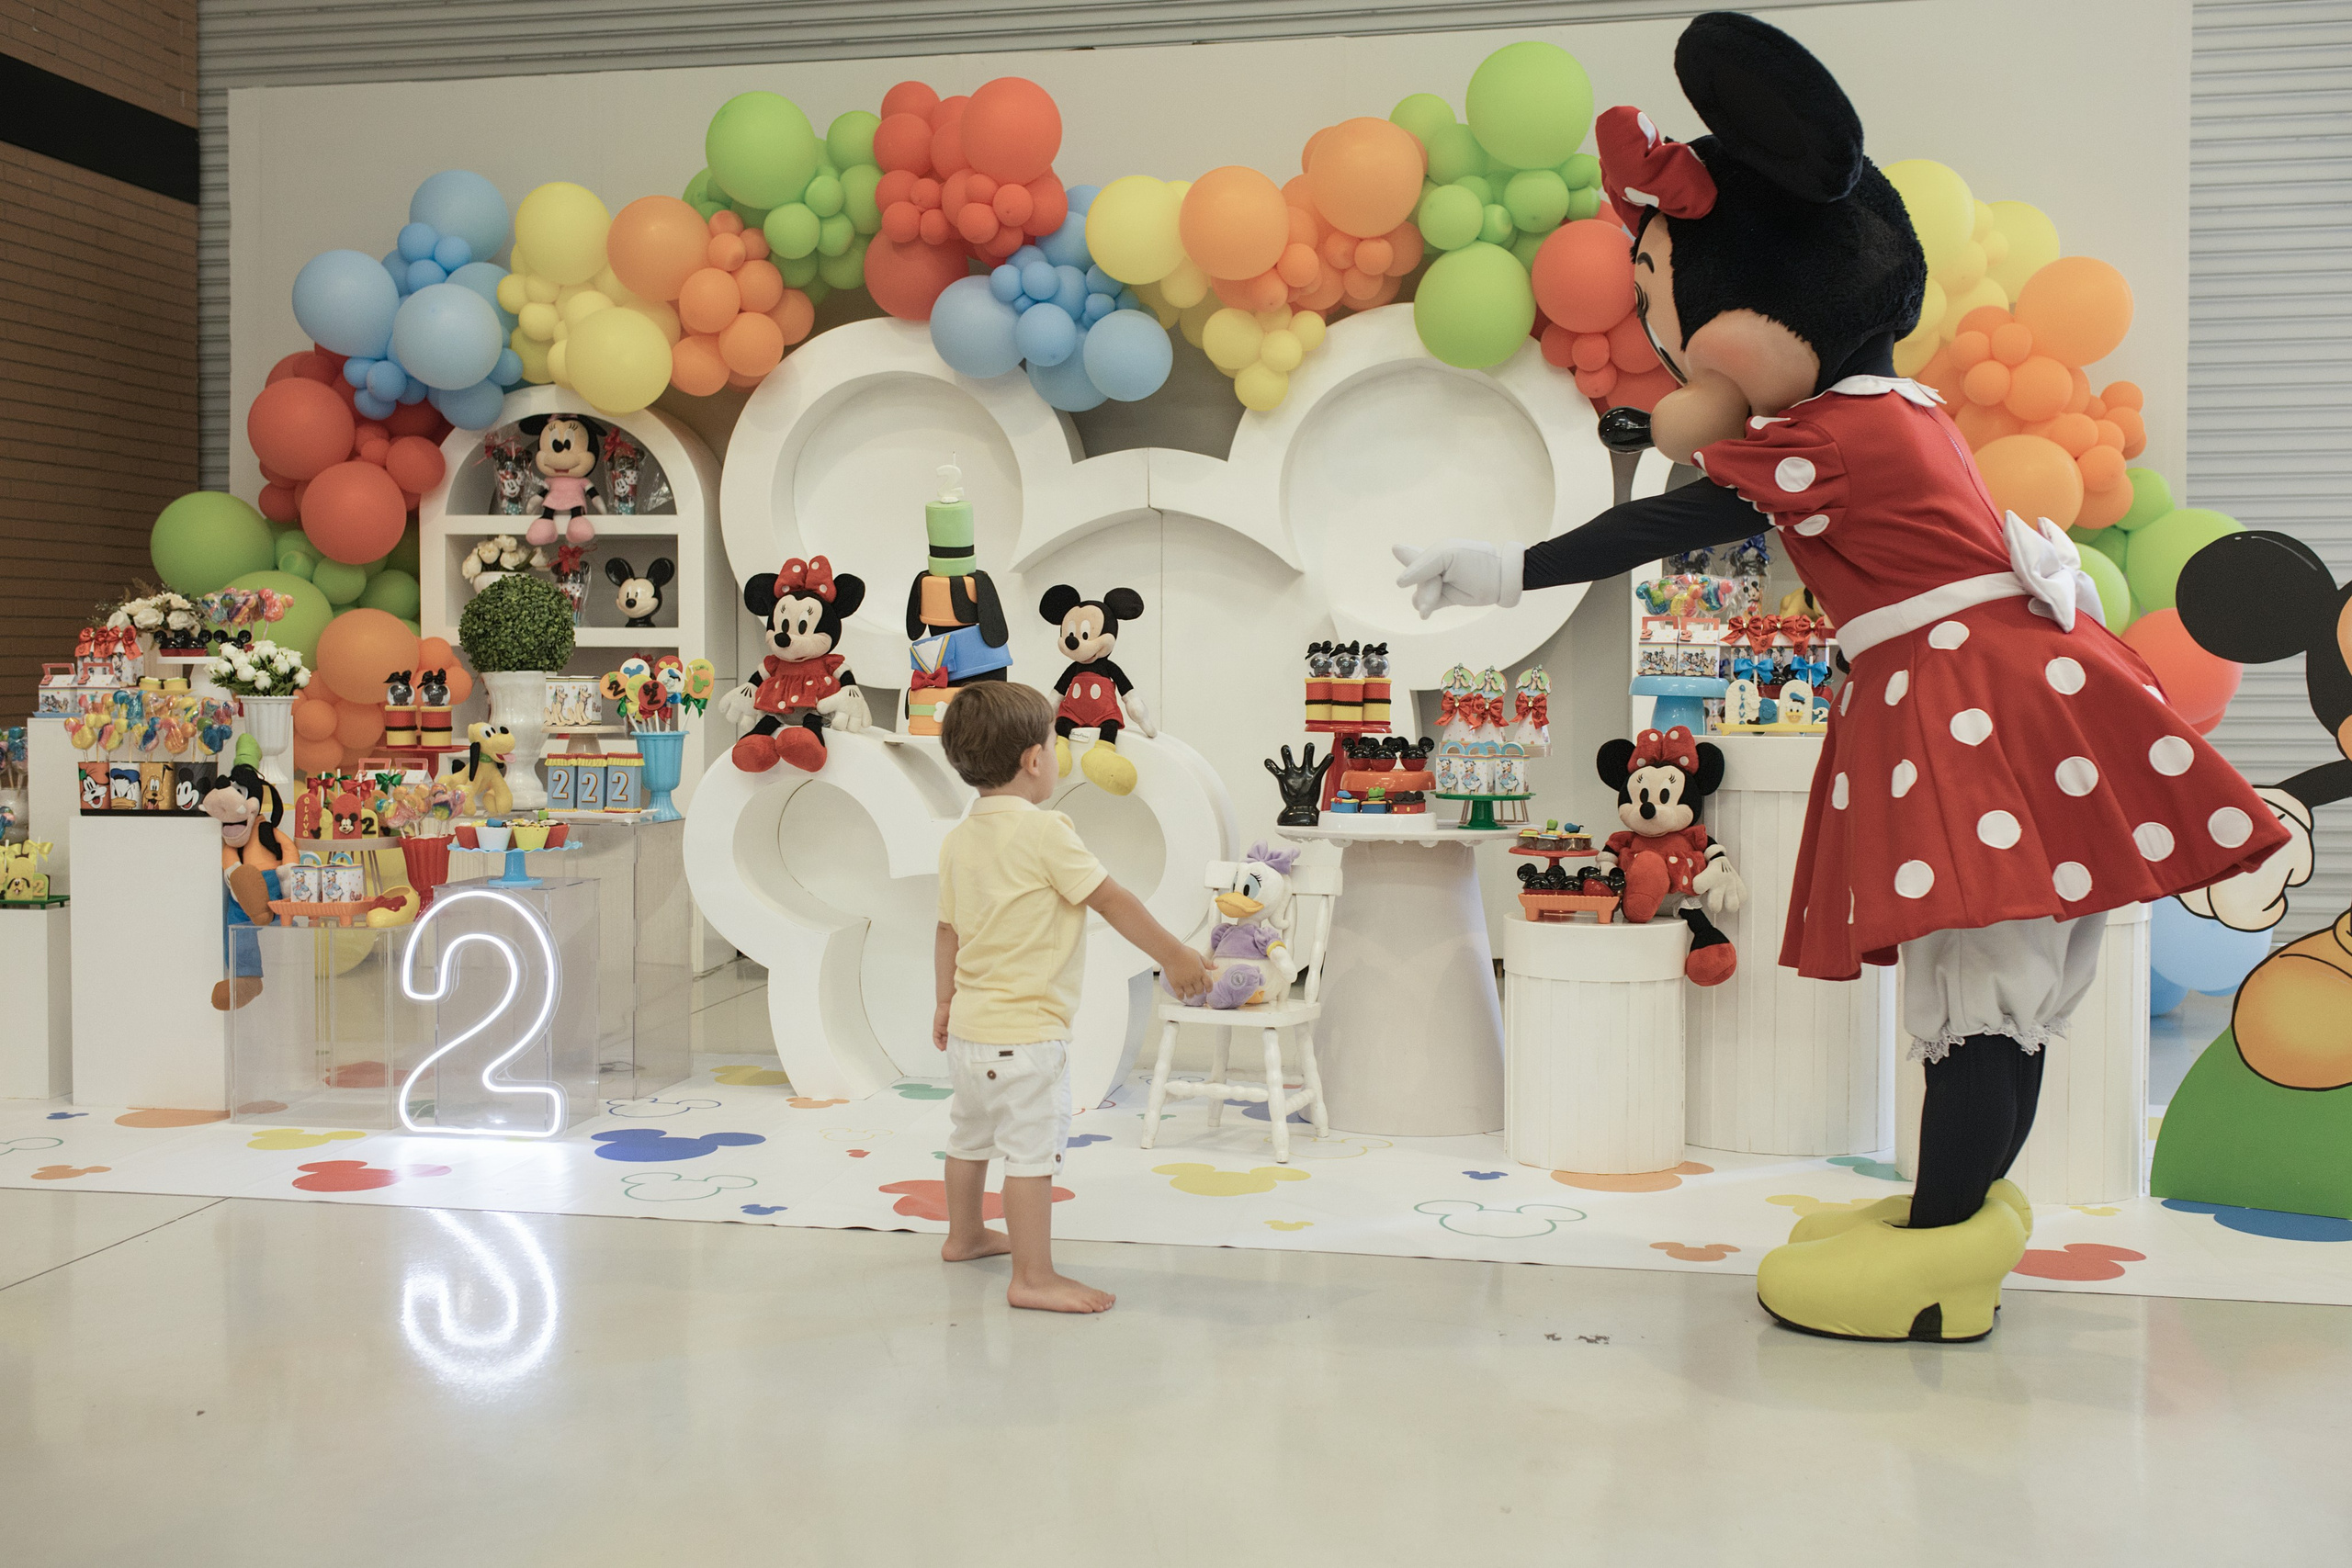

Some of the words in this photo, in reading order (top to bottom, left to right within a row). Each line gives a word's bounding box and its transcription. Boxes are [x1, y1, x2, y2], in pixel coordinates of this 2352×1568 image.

[936, 465, 965, 497] 2
[1640, 628, 1653, 640] 2
[1679, 629, 1693, 642] 2
[1812, 706, 1829, 725] 2
[552, 769, 570, 799] 2
[581, 773, 597, 803] 2
[611, 771, 628, 801] 2
[360, 817, 377, 835] 2
[33, 879, 46, 897] 2
[399, 889, 564, 1137] 2
